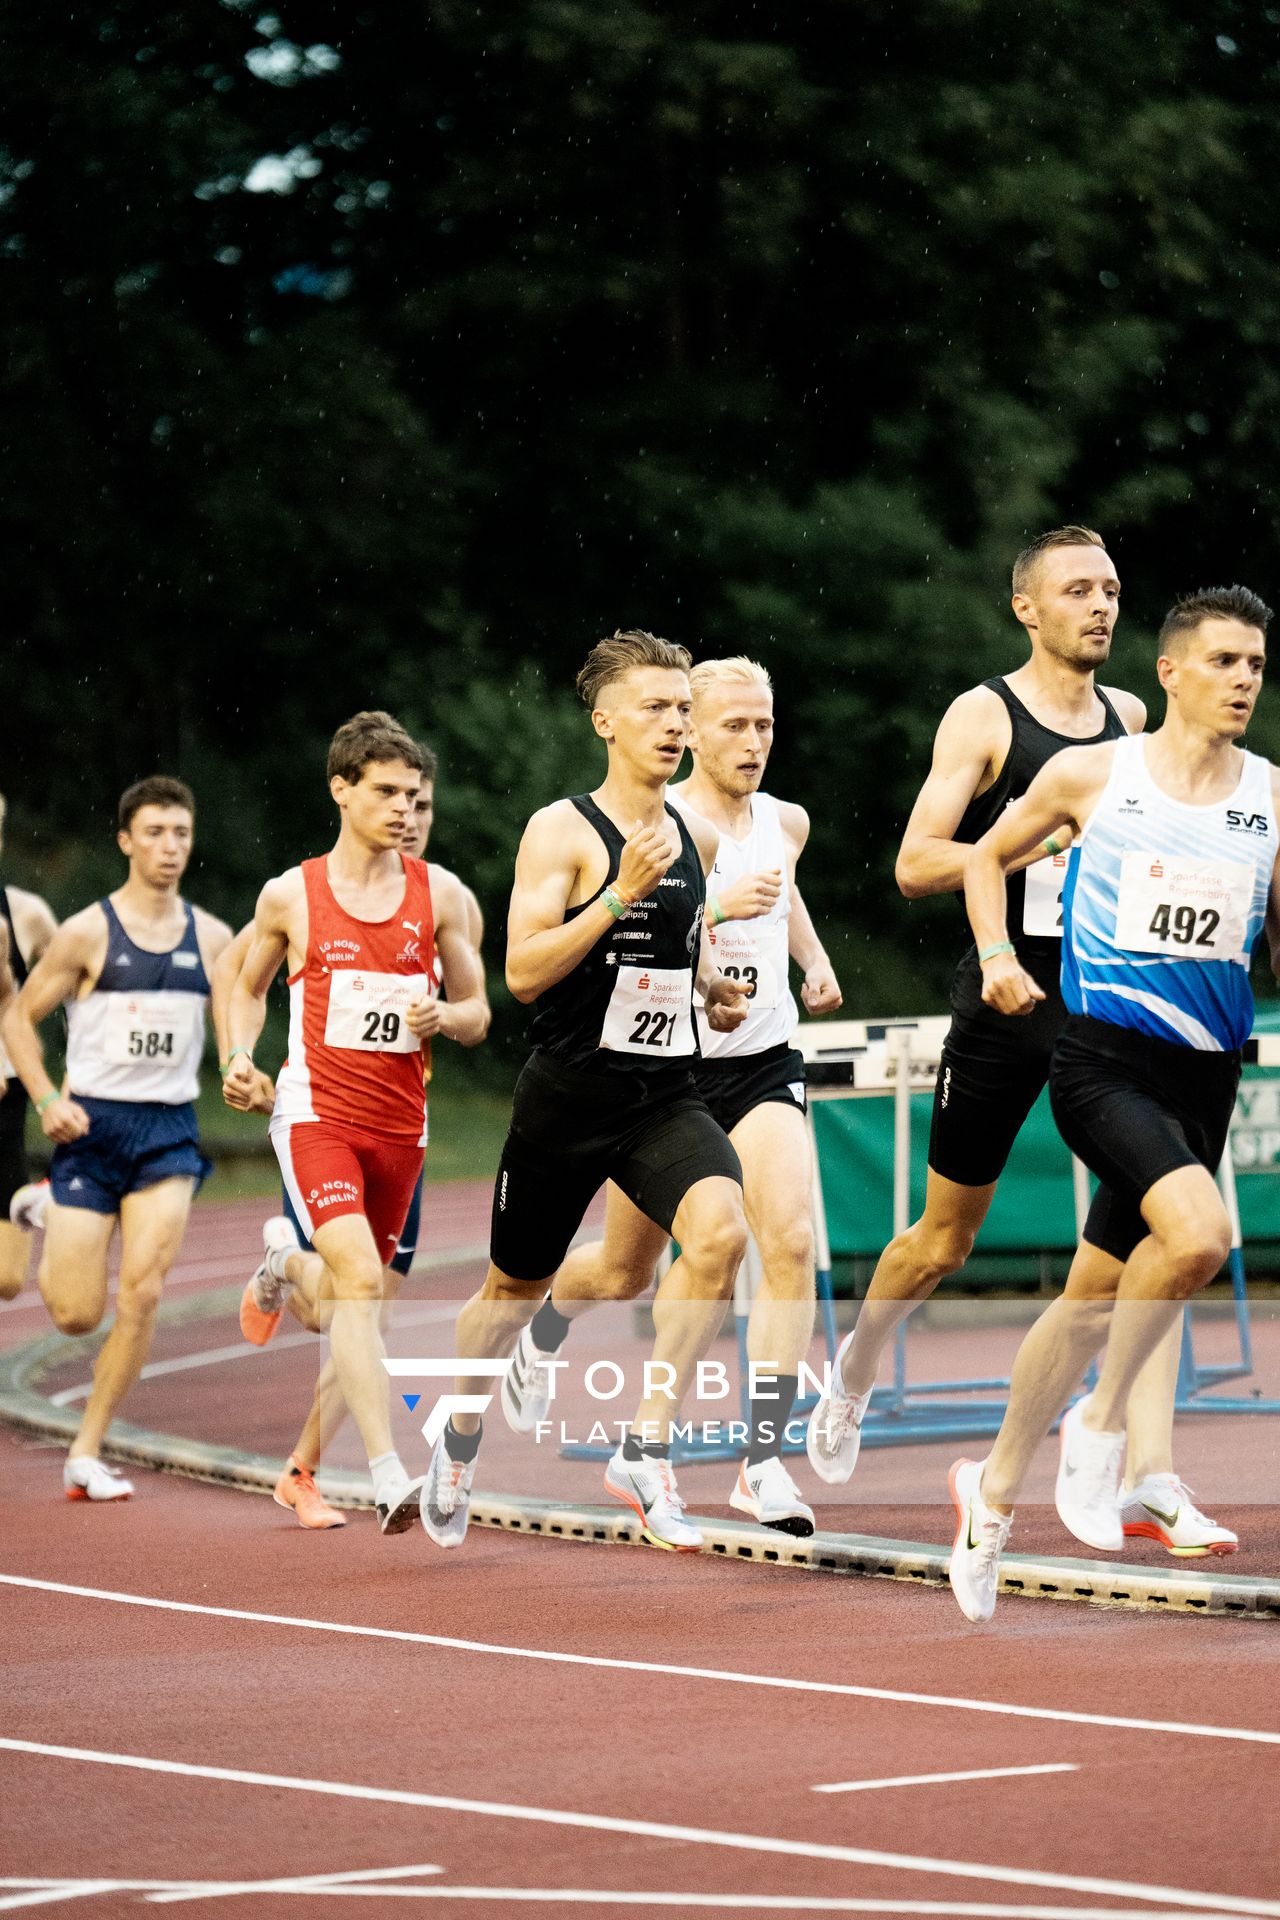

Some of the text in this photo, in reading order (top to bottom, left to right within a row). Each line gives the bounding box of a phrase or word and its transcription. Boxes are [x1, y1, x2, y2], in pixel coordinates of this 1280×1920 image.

[1118, 807, 1143, 815] erima
[1226, 810, 1268, 831] SVS
[658, 878, 680, 887] RAFT
[1169, 872, 1222, 886] Sparkasse
[1169, 885, 1231, 902] Regensburg
[626, 911, 649, 920] eipzig
[1149, 903, 1220, 947] 492
[319, 940, 360, 953] LG NORD
[326, 953, 355, 961] BERLIN
[361, 1011, 400, 1043] 29
[628, 1010, 677, 1047] 221
[128, 1031, 174, 1057] 584
[306, 1180, 358, 1204] LG NORD
[317, 1193, 355, 1209] BERLIN
